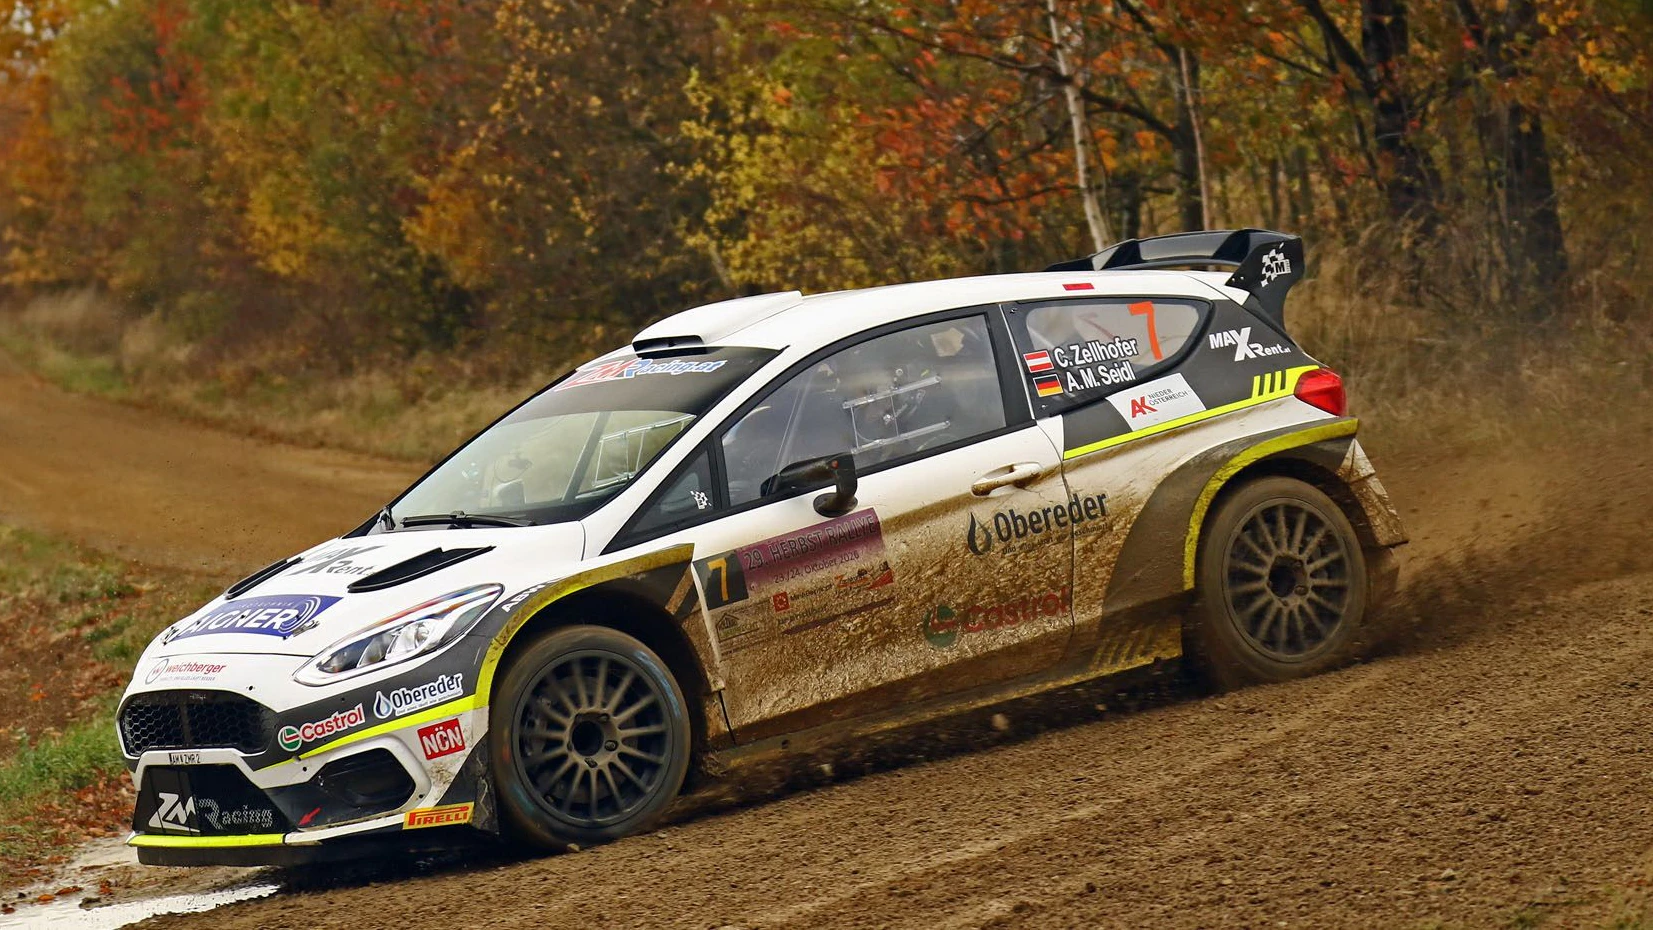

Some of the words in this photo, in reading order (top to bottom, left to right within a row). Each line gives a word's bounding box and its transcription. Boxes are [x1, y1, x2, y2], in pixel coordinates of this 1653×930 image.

[1127, 301, 1163, 360] 7
[1209, 327, 1257, 361] MAX
[1054, 347, 1074, 368] C.
[1070, 337, 1138, 364] Zellhofer
[1099, 361, 1136, 385] Seidl
[1130, 396, 1157, 418] AK
[1148, 388, 1173, 399] NIEDER
[994, 492, 1108, 542] Obereder
[743, 551, 770, 570] 29.
[768, 531, 823, 562] HERBST
[826, 515, 877, 546] RALLYE
[707, 557, 729, 602] 7
[804, 554, 838, 575] Oktober
[175, 608, 299, 638] AIGNER
[166, 662, 227, 675] weichberger
[392, 674, 463, 709] Obereder
[301, 707, 364, 740] Castrol
[422, 725, 463, 756] NÖN
[148, 792, 200, 832] ZM
[197, 797, 273, 830] Racing
[408, 805, 470, 826] PIRELLI
